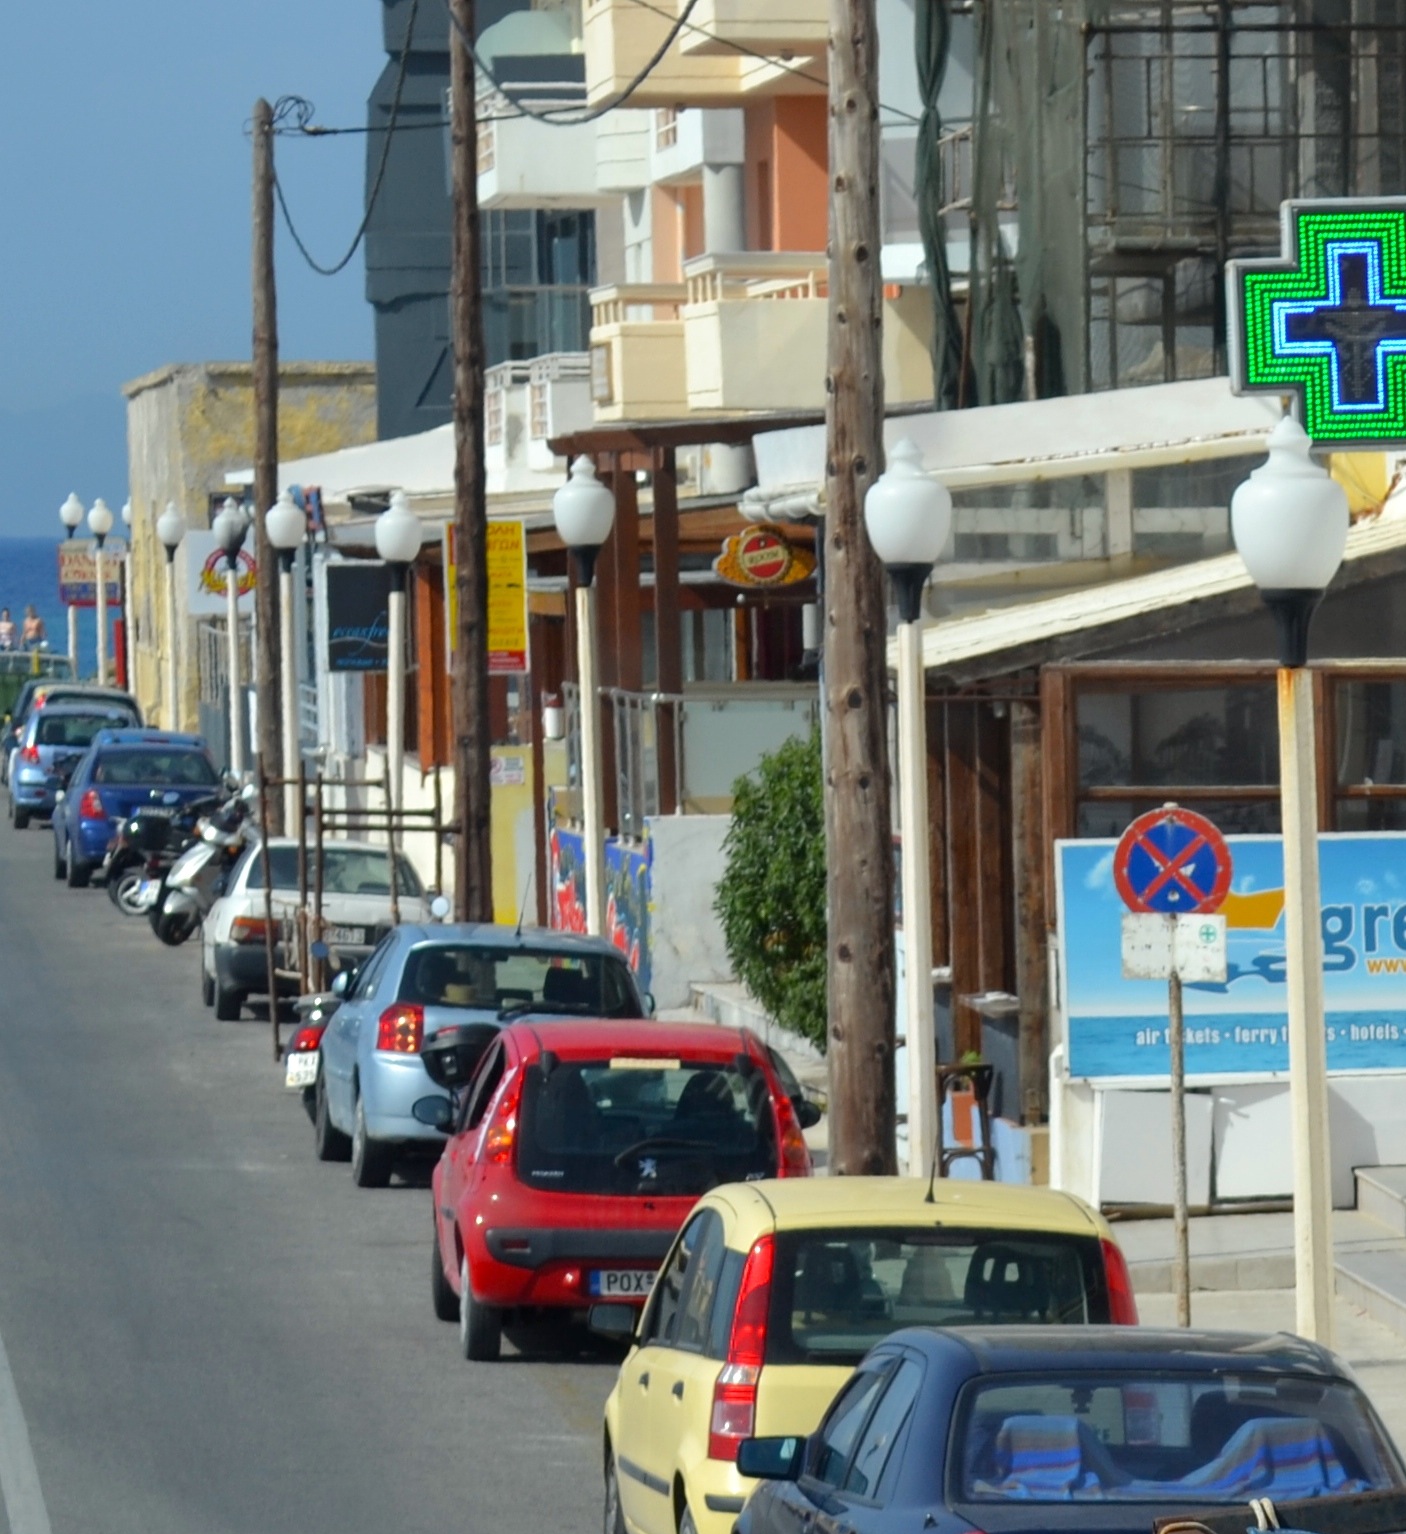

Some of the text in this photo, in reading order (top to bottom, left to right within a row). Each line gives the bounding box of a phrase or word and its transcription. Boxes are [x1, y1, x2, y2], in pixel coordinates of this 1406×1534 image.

[1135, 1028, 1160, 1045] air
[1234, 1025, 1278, 1045] ferry
[1350, 1023, 1400, 1041] hotels
